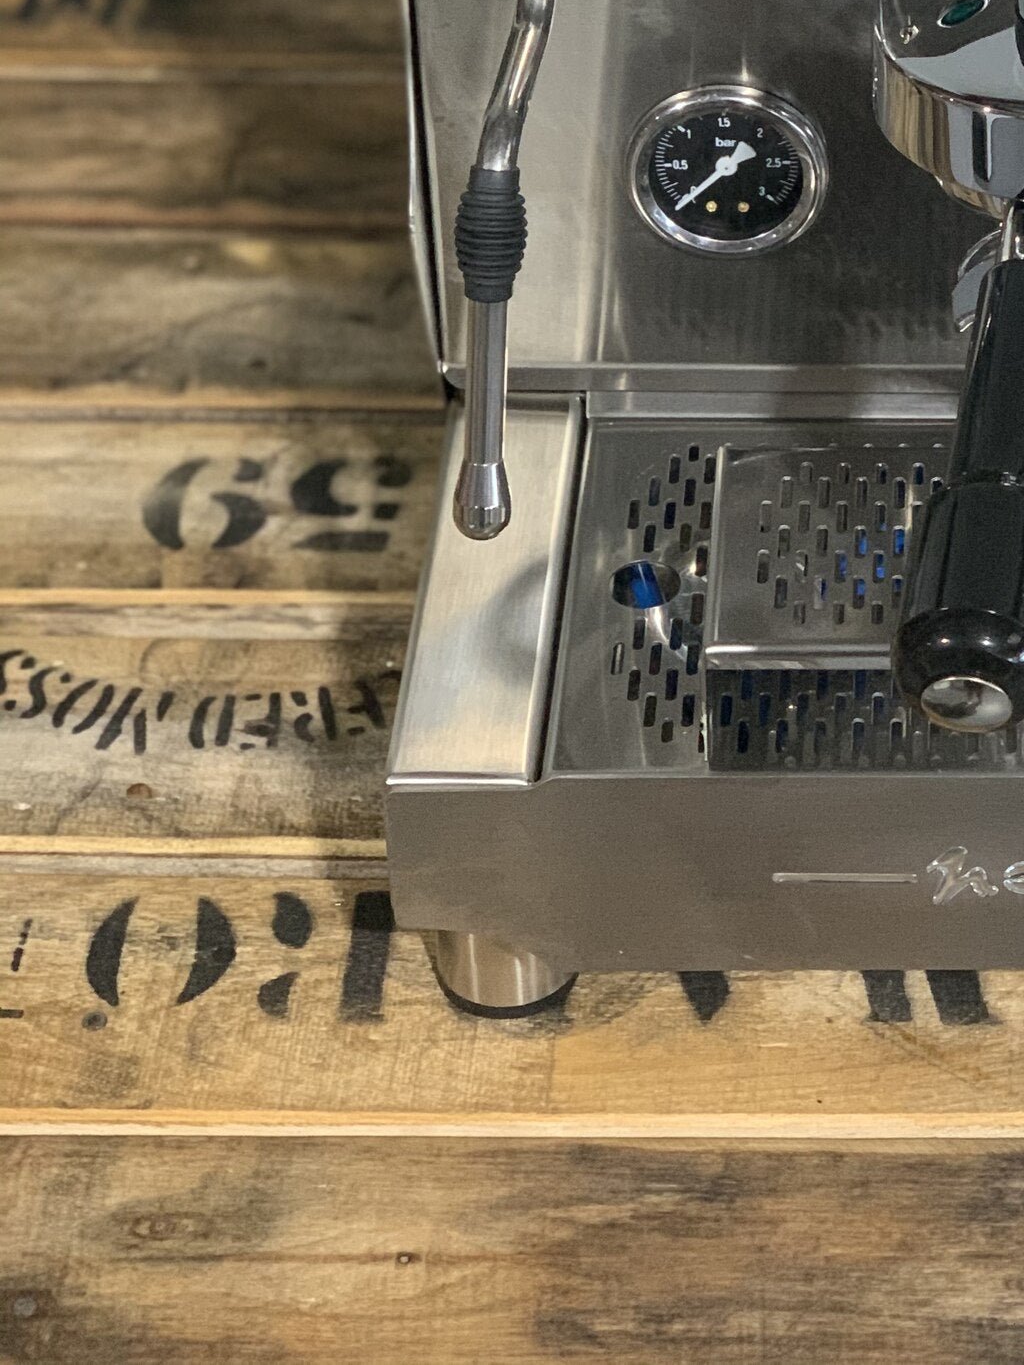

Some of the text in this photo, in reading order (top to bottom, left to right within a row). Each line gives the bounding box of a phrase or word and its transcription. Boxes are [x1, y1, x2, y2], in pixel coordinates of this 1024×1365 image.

[717, 117, 731, 128] 1.5
[686, 129, 692, 139] 1
[756, 128, 764, 138] 2
[715, 137, 737, 147] bar
[672, 159, 689, 170] 0.5
[765, 158, 782, 168] 2.5
[758, 186, 766, 196] 3
